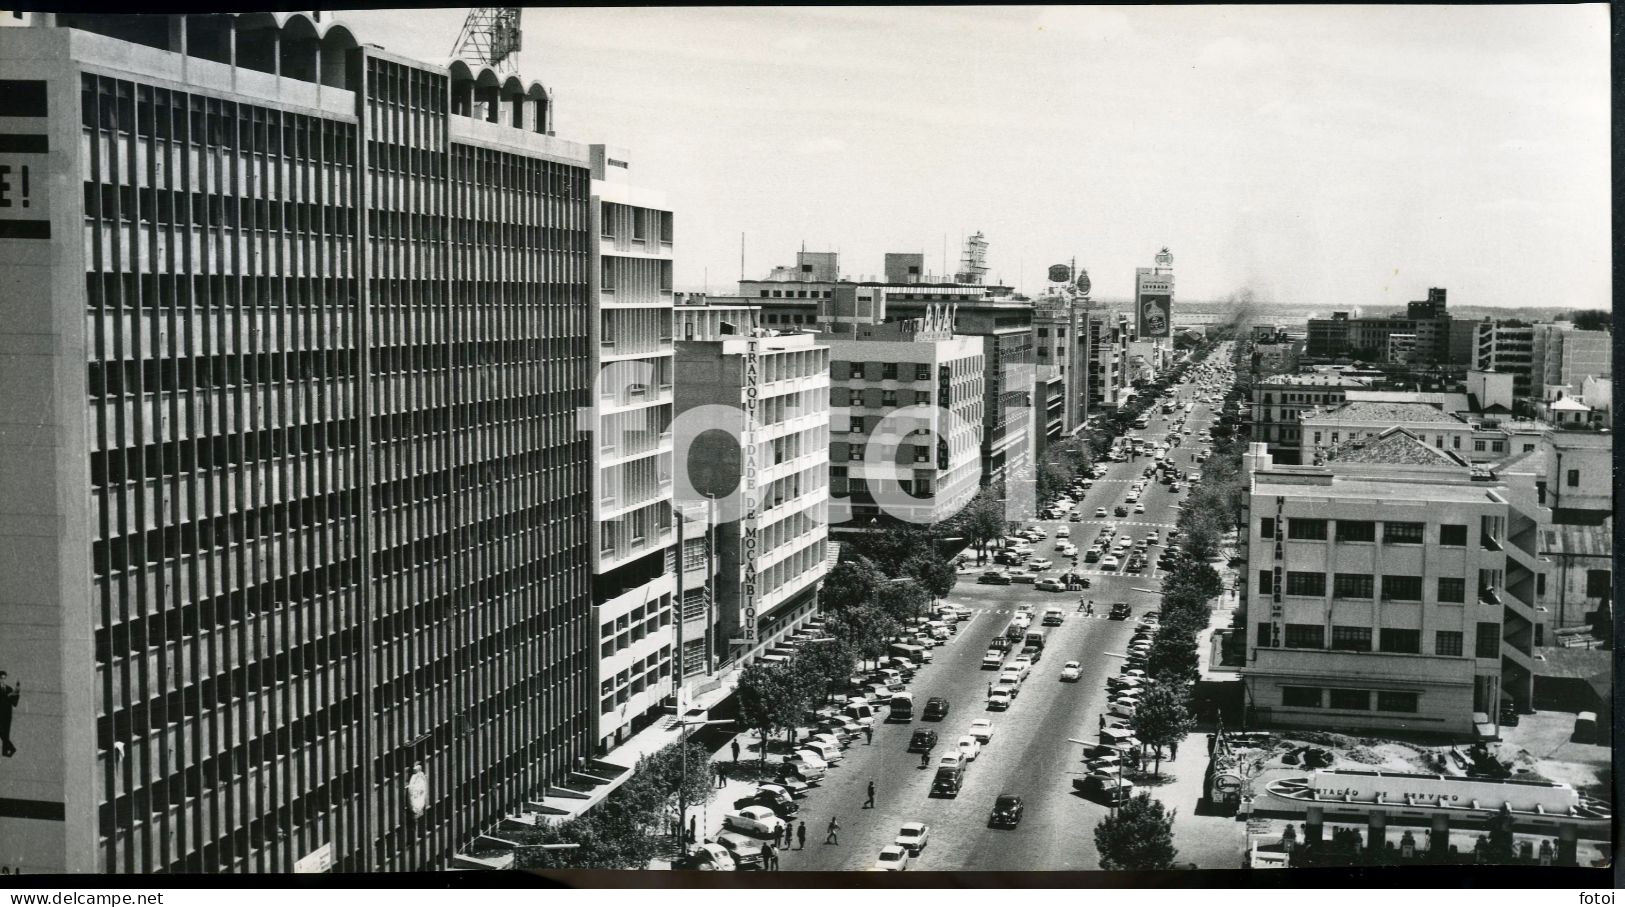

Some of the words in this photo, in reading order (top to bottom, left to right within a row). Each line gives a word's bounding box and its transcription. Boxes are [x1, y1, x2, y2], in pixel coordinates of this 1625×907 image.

[924, 303, 958, 332] BOAC
[747, 341, 757, 490] TRANQUILIDADE
[746, 498, 756, 520] DE
[1275, 495, 1284, 560] HILLMAN
[745, 527, 756, 640] MOÇAMBIQUE
[1310, 788, 1359, 796] STAÇÃO
